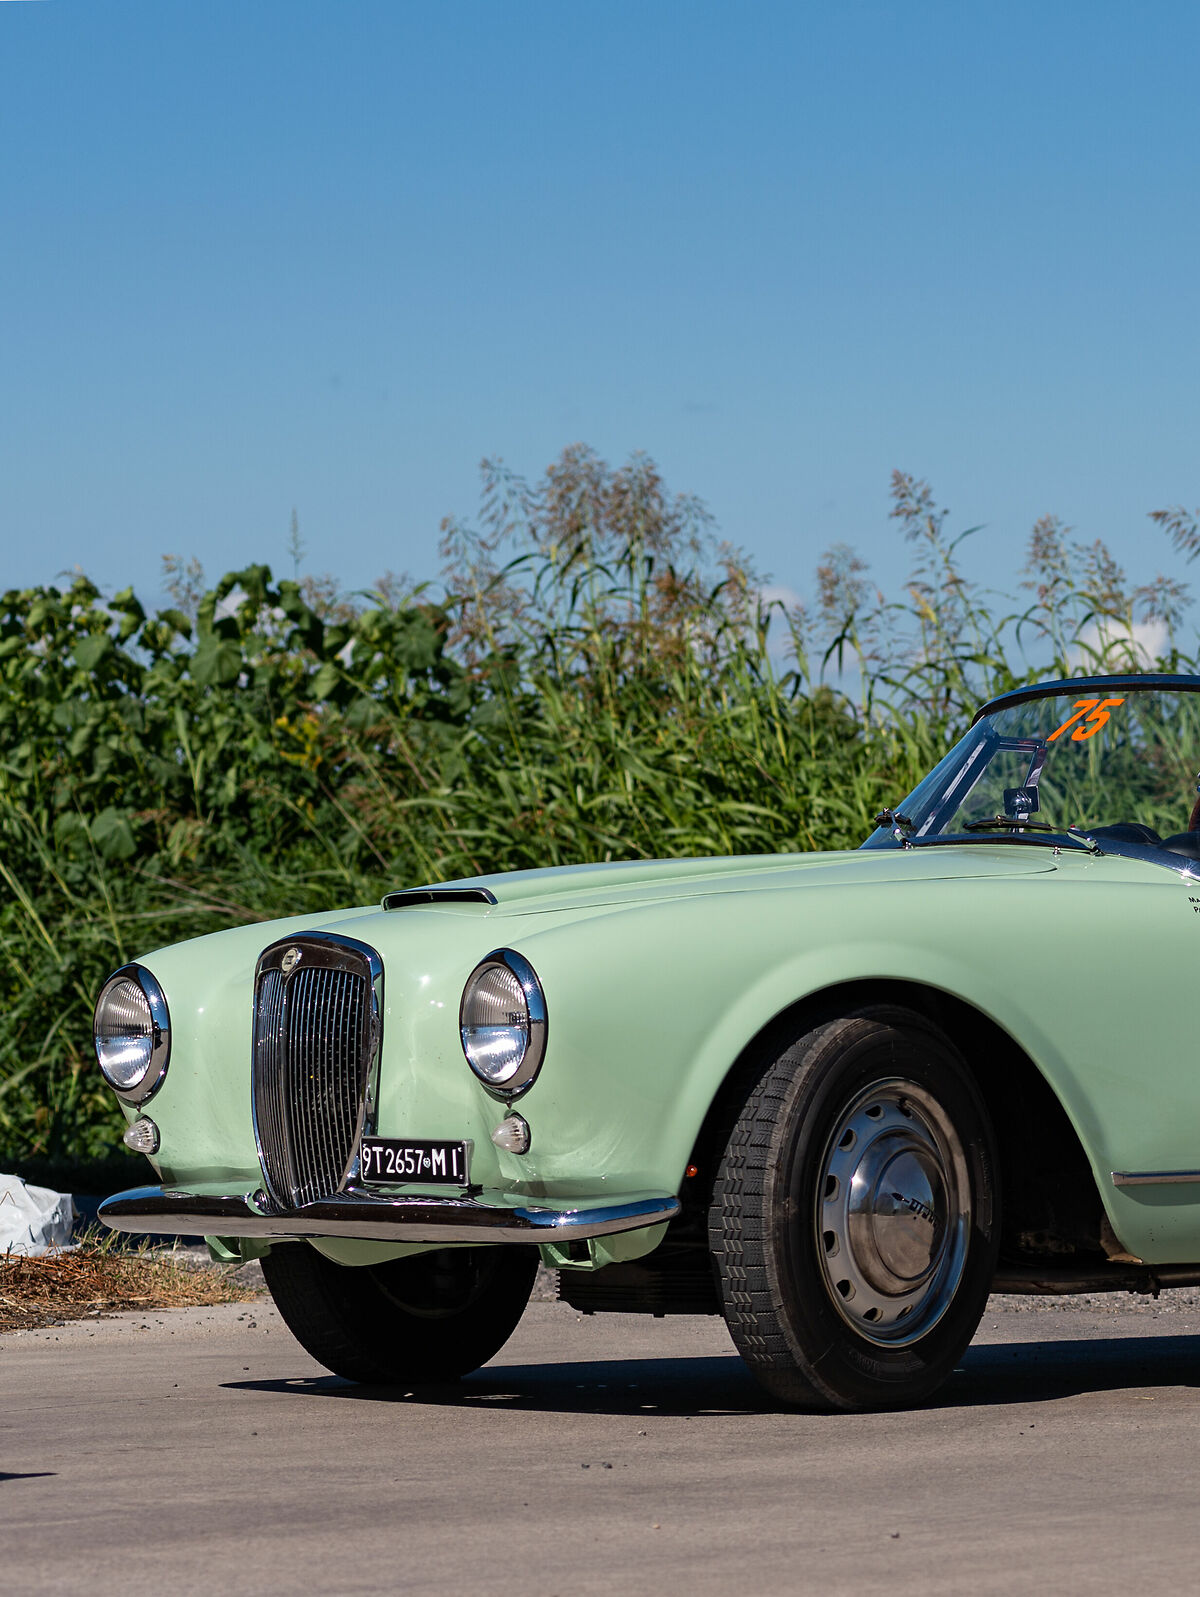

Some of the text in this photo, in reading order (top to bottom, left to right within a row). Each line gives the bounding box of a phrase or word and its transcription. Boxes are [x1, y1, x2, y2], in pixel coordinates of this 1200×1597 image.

[1046, 698, 1125, 741] 75
[363, 1146, 458, 1176] 9T2657 MI
